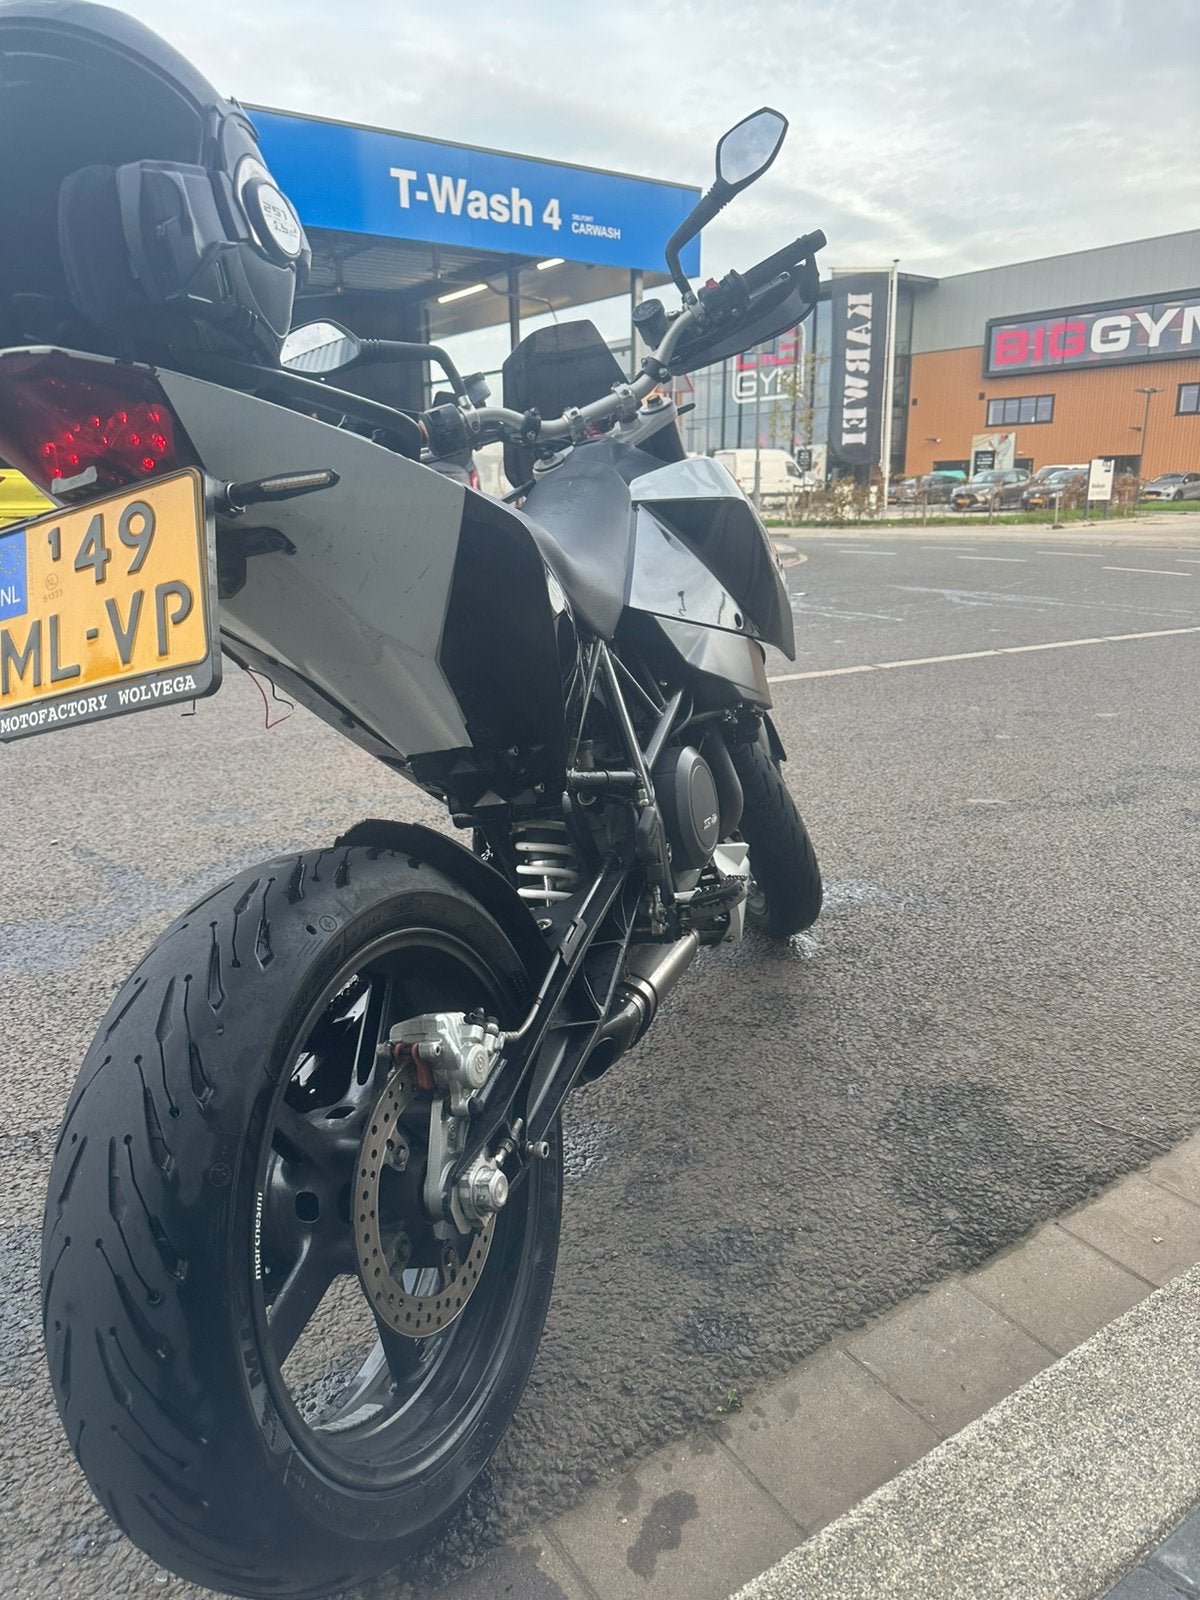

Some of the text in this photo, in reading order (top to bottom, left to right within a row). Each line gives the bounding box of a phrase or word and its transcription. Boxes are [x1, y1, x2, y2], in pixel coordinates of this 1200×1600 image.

[389, 167, 563, 231] T-Wash 4
[571, 222, 621, 240] CARWASH
[0, 585, 21, 607] NL
[0, 674, 197, 733] MOTOFACTORY WOLVEGA
